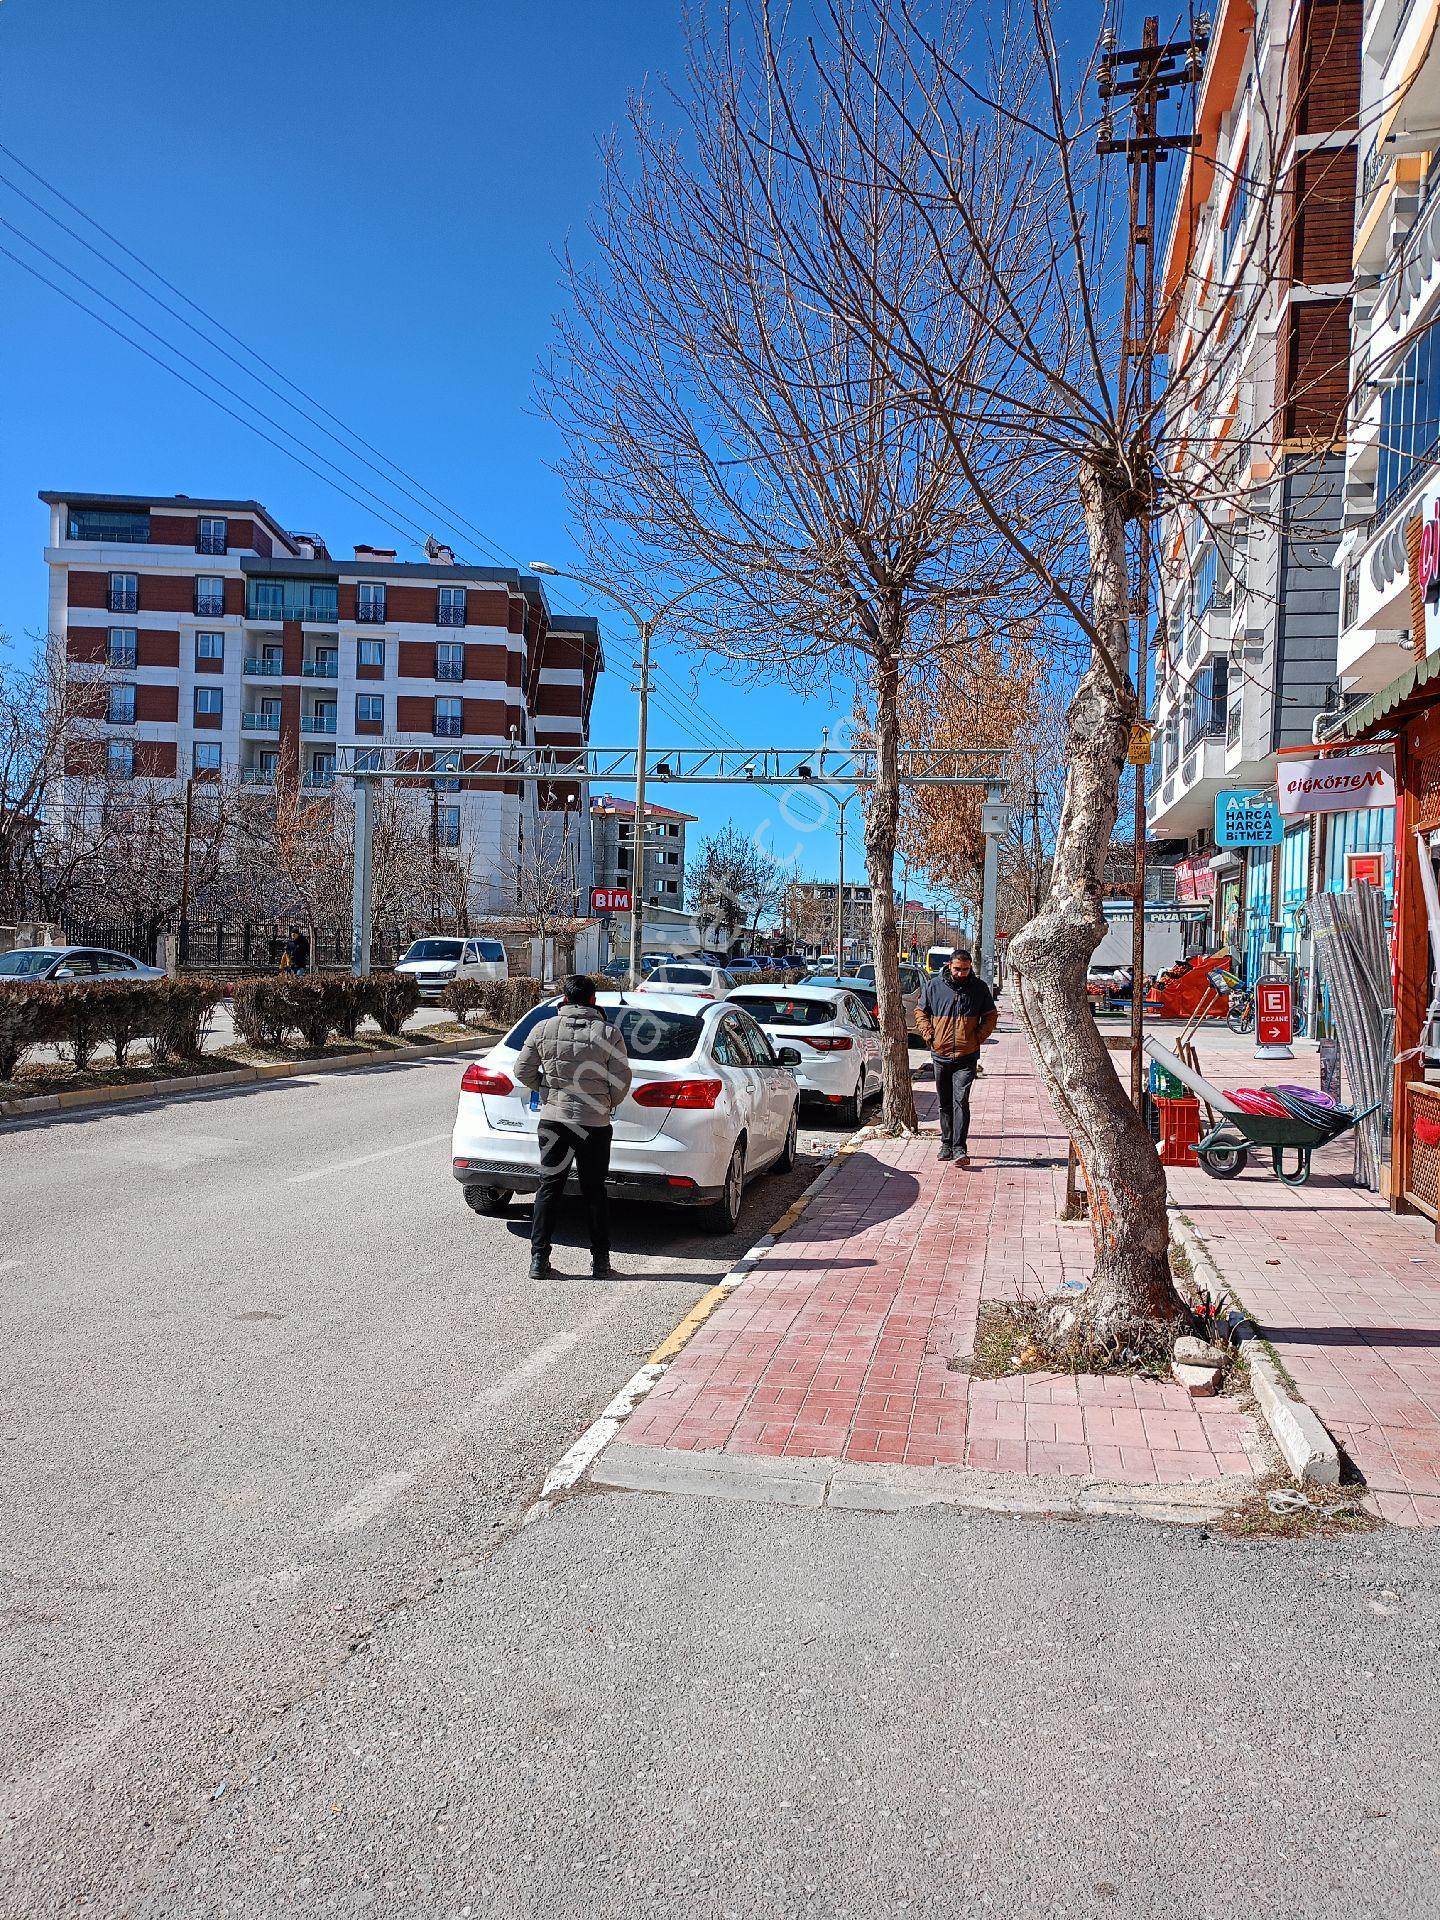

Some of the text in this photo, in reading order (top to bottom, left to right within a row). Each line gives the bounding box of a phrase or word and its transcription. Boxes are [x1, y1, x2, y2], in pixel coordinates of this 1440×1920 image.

[1226, 811, 1272, 820] HARCA
[1226, 821, 1272, 830] HARCA
[1267, 993, 1282, 1010] E
